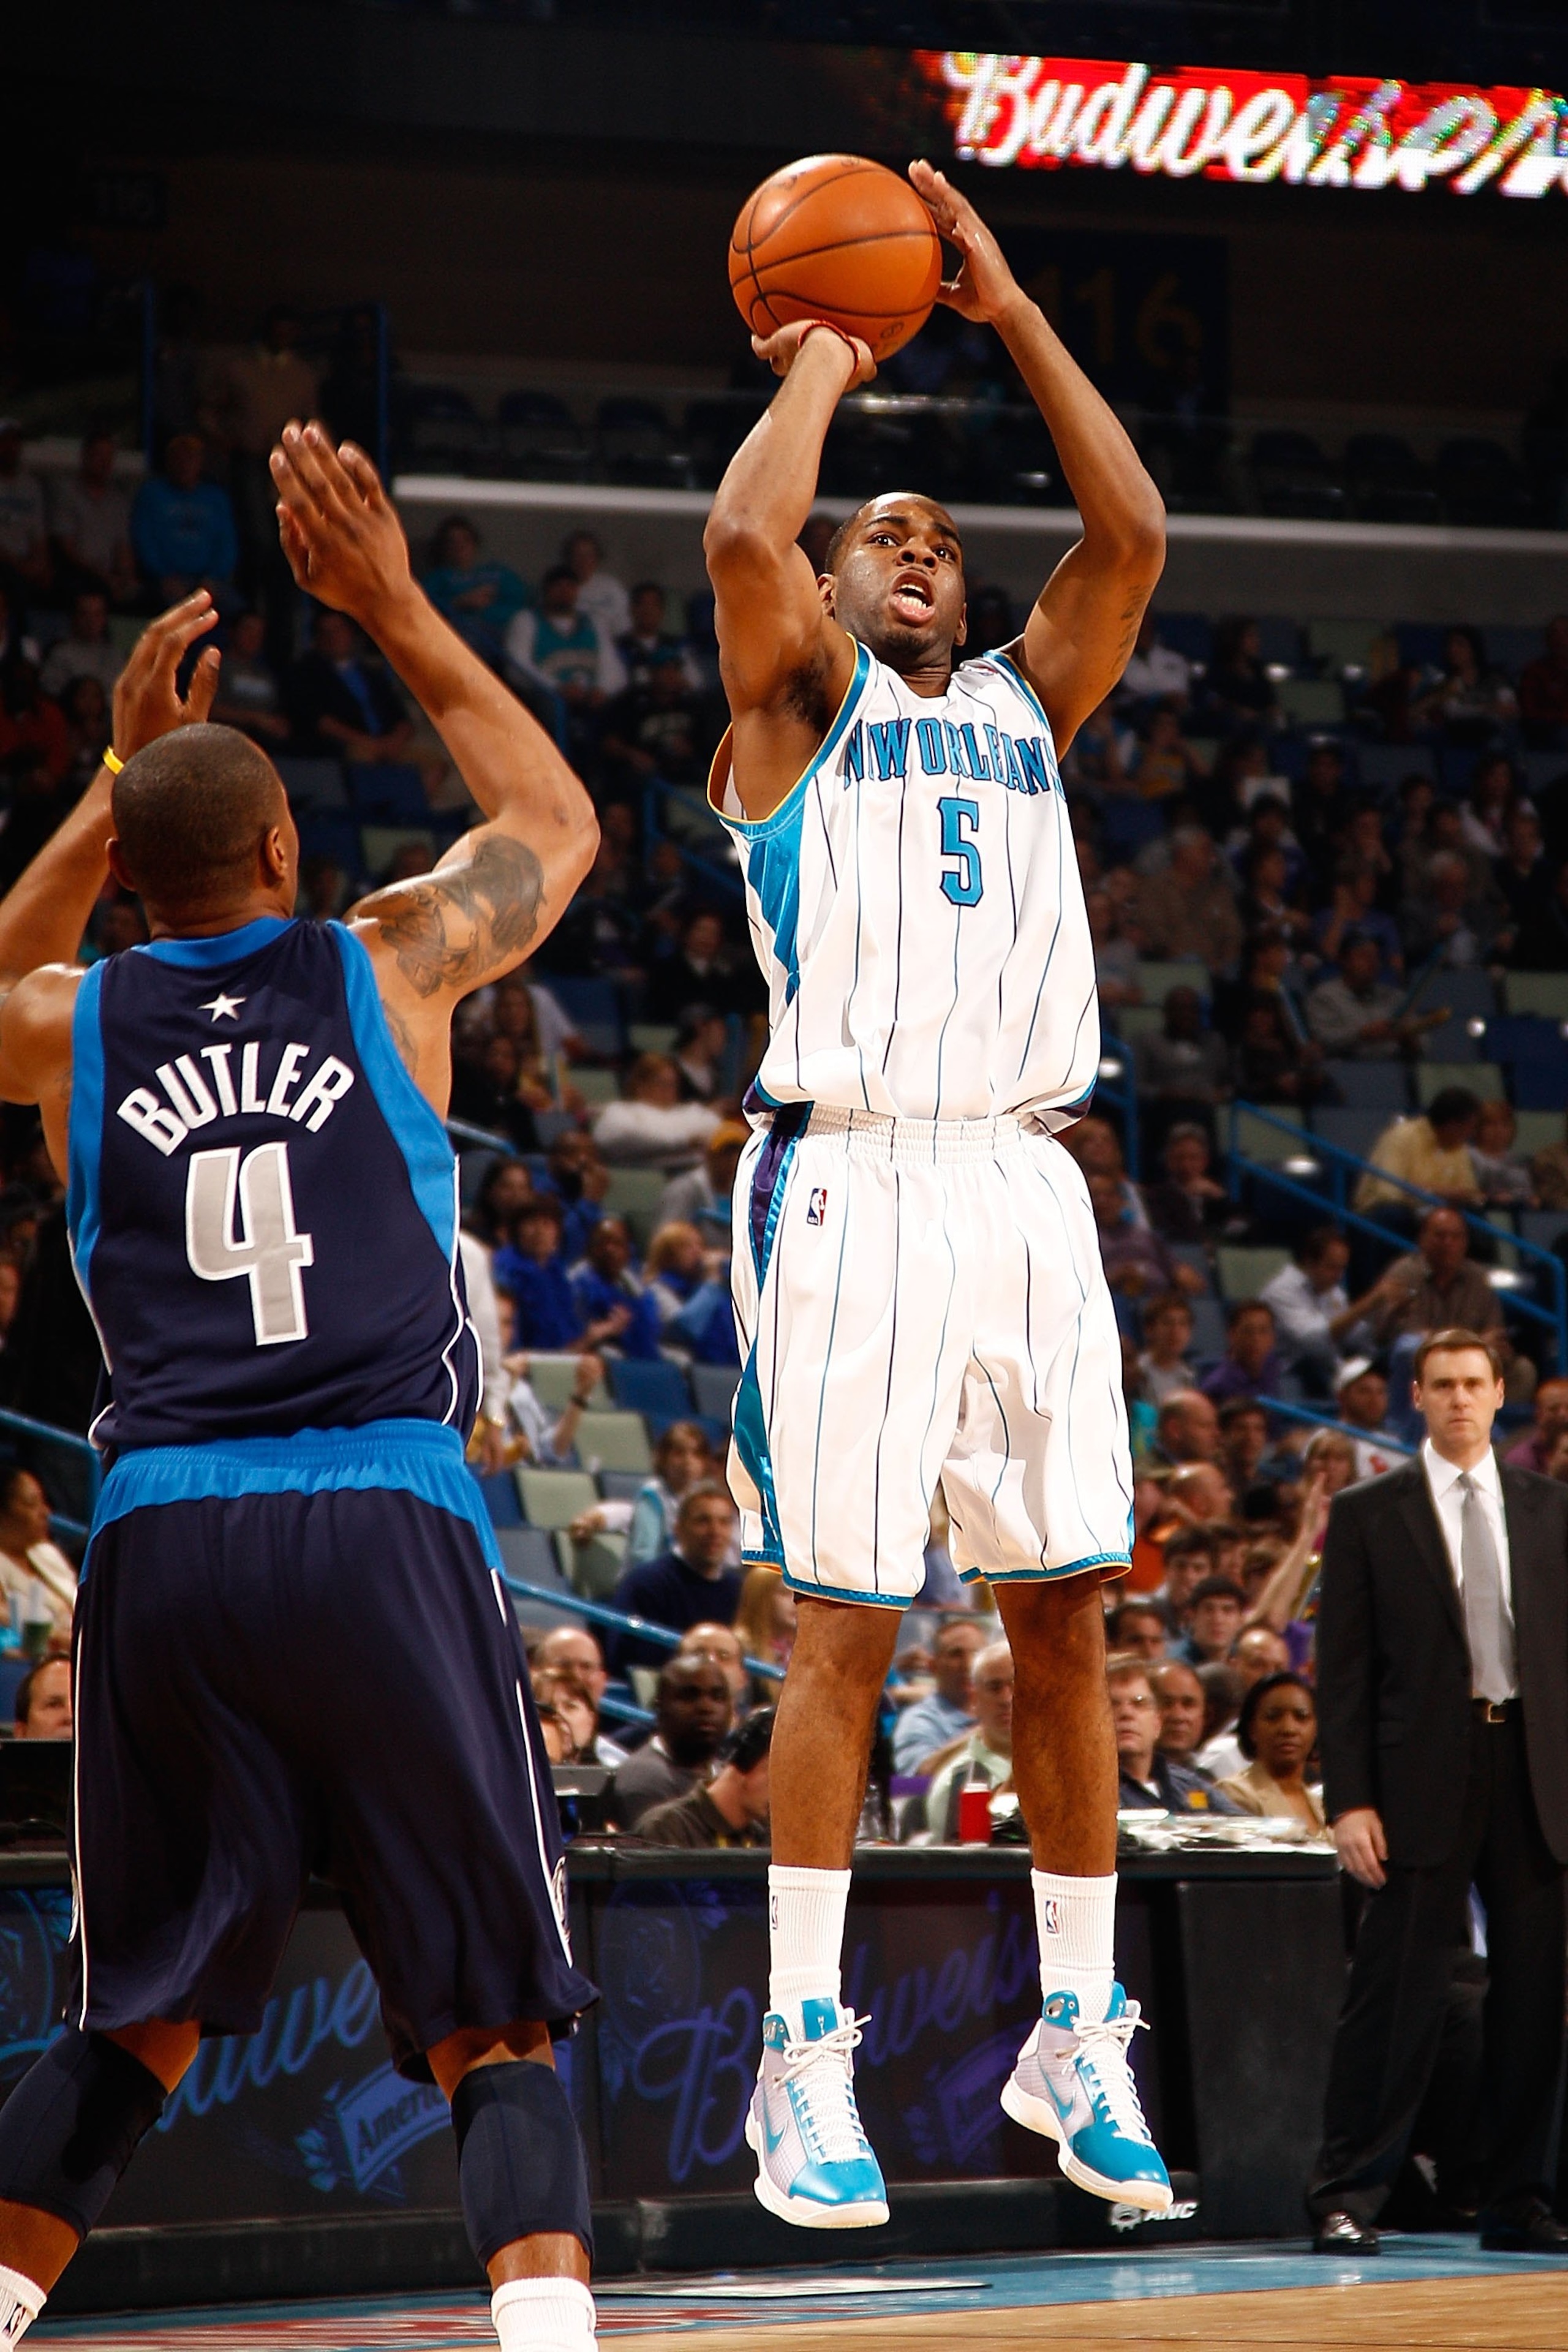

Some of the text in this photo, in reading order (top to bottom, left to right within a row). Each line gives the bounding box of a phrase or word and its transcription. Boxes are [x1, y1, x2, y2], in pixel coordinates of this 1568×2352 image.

[1025, 263, 1203, 369] 116
[843, 718, 911, 791] NW
[936, 796, 984, 908] 5
[116, 1041, 355, 1157] BUTLER
[185, 1140, 314, 1346] 4
